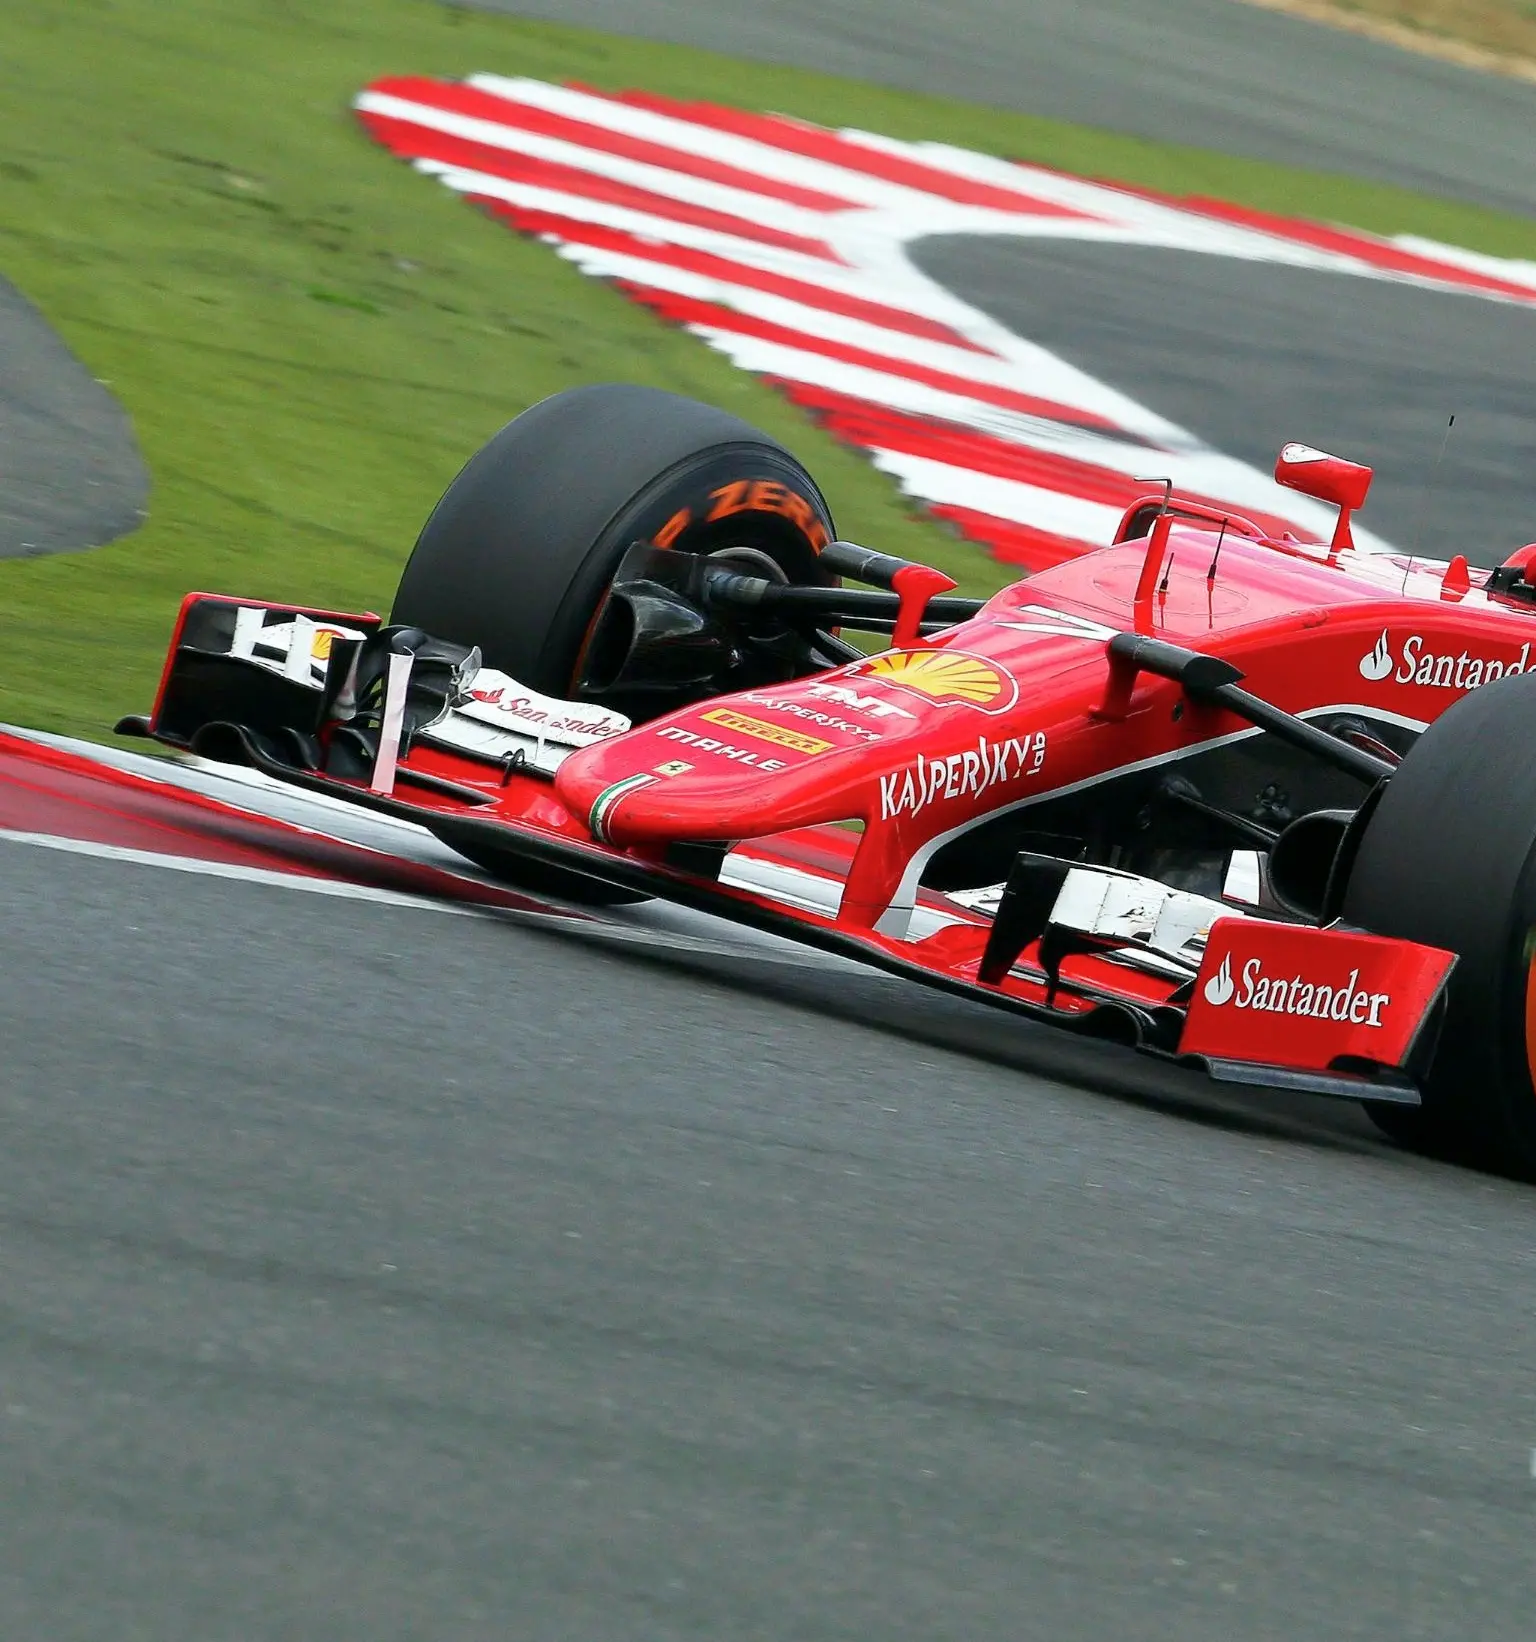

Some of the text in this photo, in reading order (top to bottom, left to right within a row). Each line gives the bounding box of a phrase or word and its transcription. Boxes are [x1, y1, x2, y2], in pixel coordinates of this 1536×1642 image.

[805, 681, 918, 719] TNT
[656, 726, 788, 773] MAHLE
[880, 735, 1031, 821] KASPERSKY
[1235, 957, 1390, 1028] Santander
